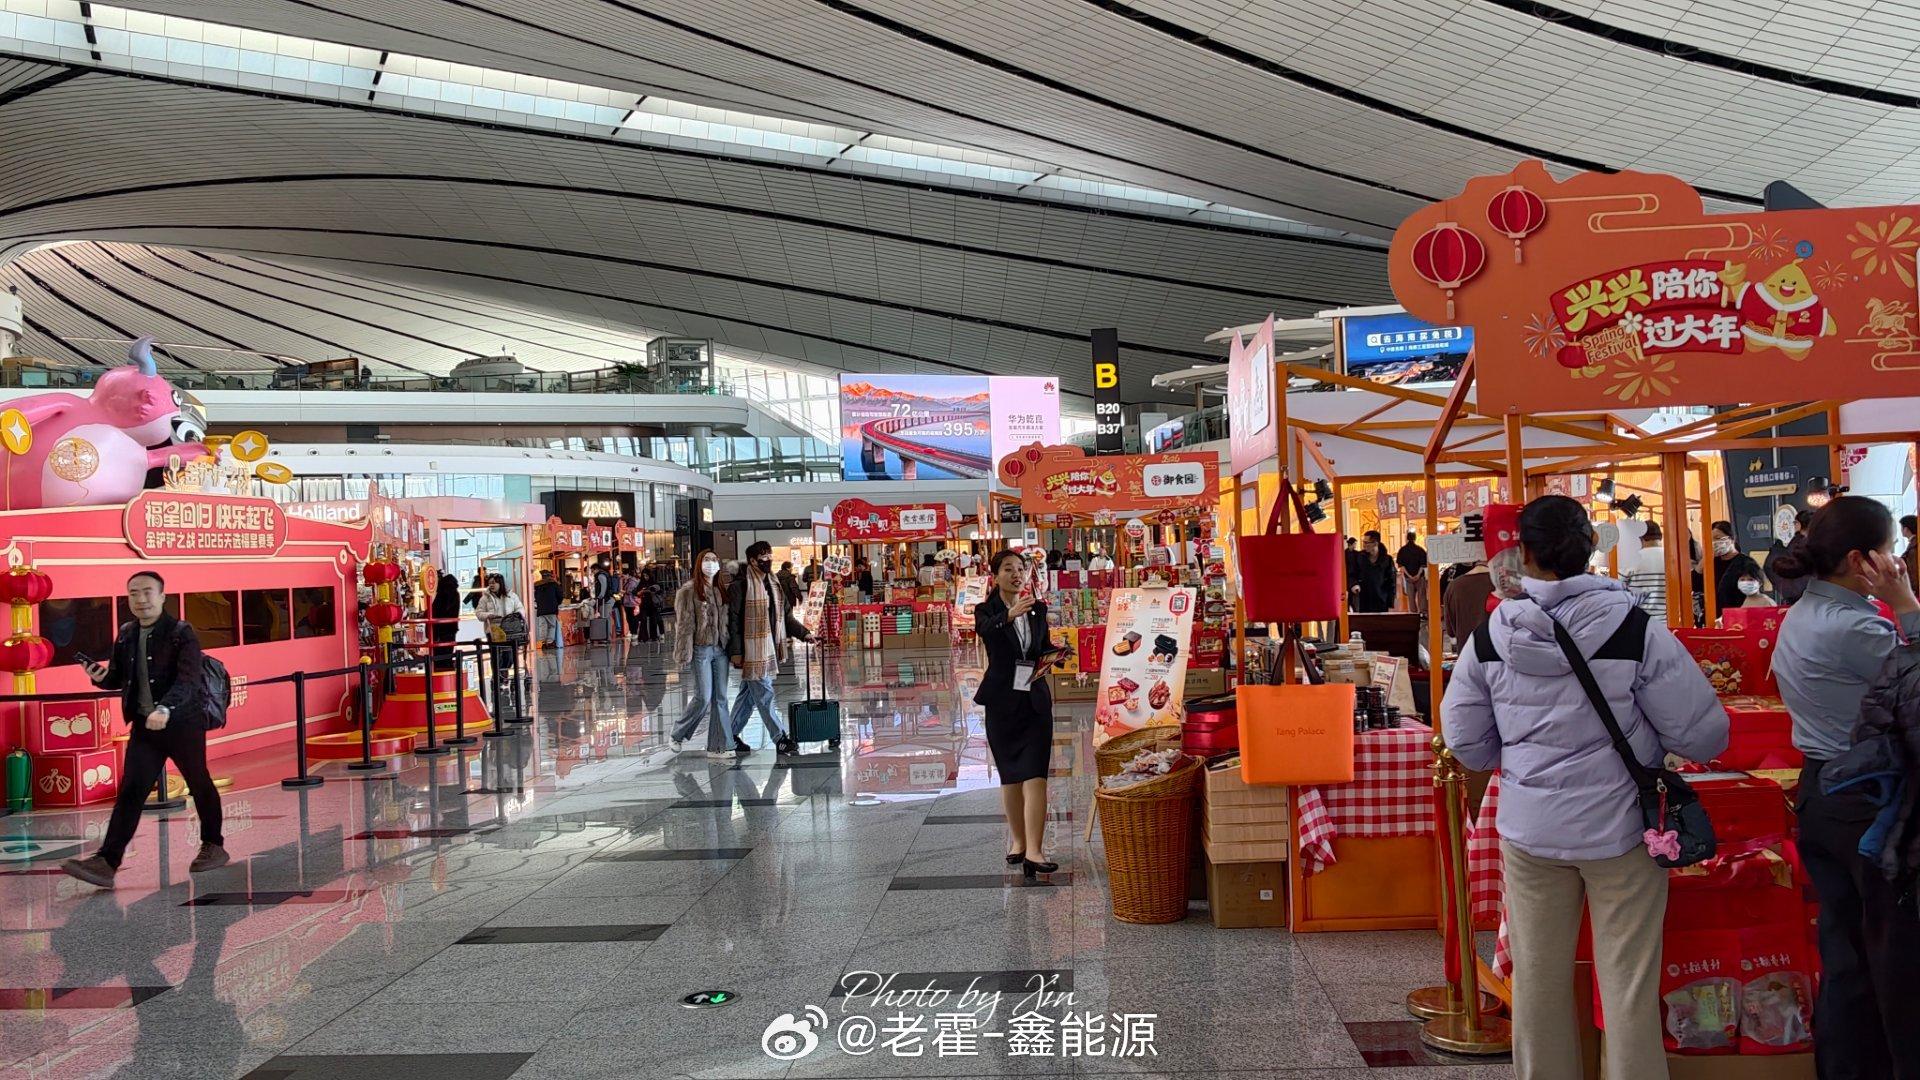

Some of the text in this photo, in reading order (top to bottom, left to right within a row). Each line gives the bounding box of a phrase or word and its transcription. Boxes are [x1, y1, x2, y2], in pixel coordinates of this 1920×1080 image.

[1564, 268, 1721, 333] 兴兴陪你
[1583, 325, 1626, 350] Spring
[1642, 313, 1741, 349] 过大年
[1586, 333, 1639, 364] Festival
[1096, 362, 1118, 389] B
[1096, 403, 1120, 415] B20
[1097, 423, 1120, 435] B37
[1163, 473, 1195, 486] 御食园
[1067, 484, 1096, 496] 过大年
[145, 500, 275, 531] 福星回归 快乐起飞
[287, 502, 361, 521] Holiland
[581, 500, 623, 518] ZEGNA
[146, 531, 275, 549] 金铲铲之战 2026天选福星赛季
[1275, 727, 1326, 738] Tang Palace
